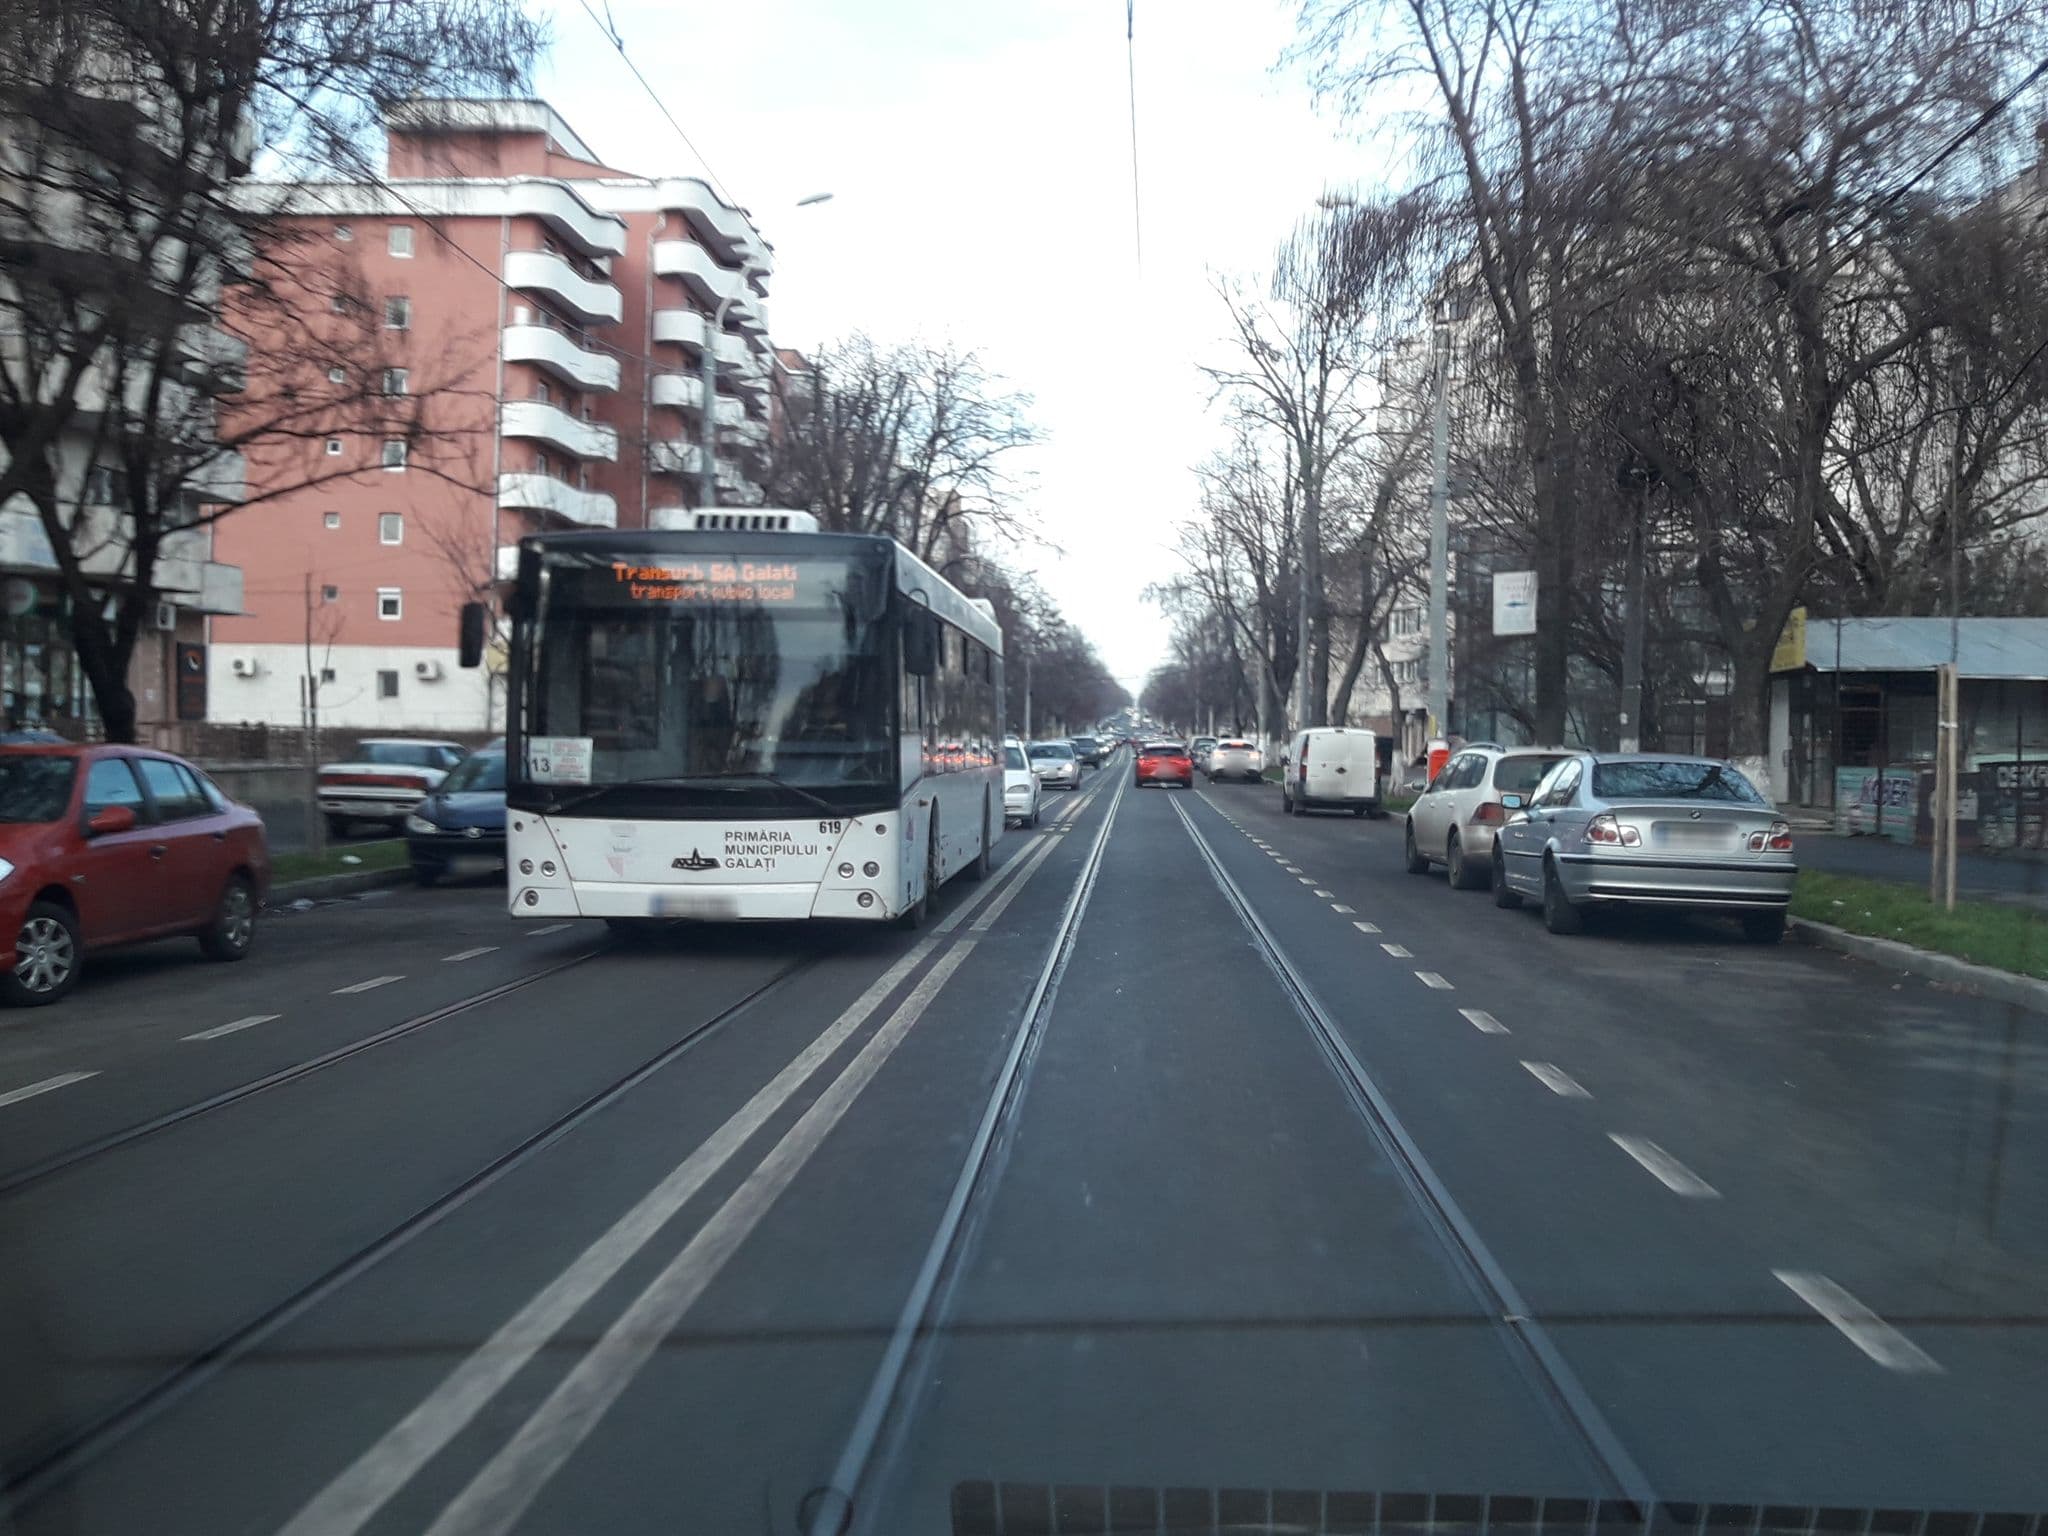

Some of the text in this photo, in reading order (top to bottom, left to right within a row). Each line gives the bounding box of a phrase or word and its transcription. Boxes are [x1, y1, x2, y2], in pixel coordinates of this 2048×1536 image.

[532, 757, 550, 772] 13
[819, 821, 841, 834] 619
[725, 829, 792, 842] PRIMĂRIA
[725, 845, 818, 856] MUNICIPIULUI
